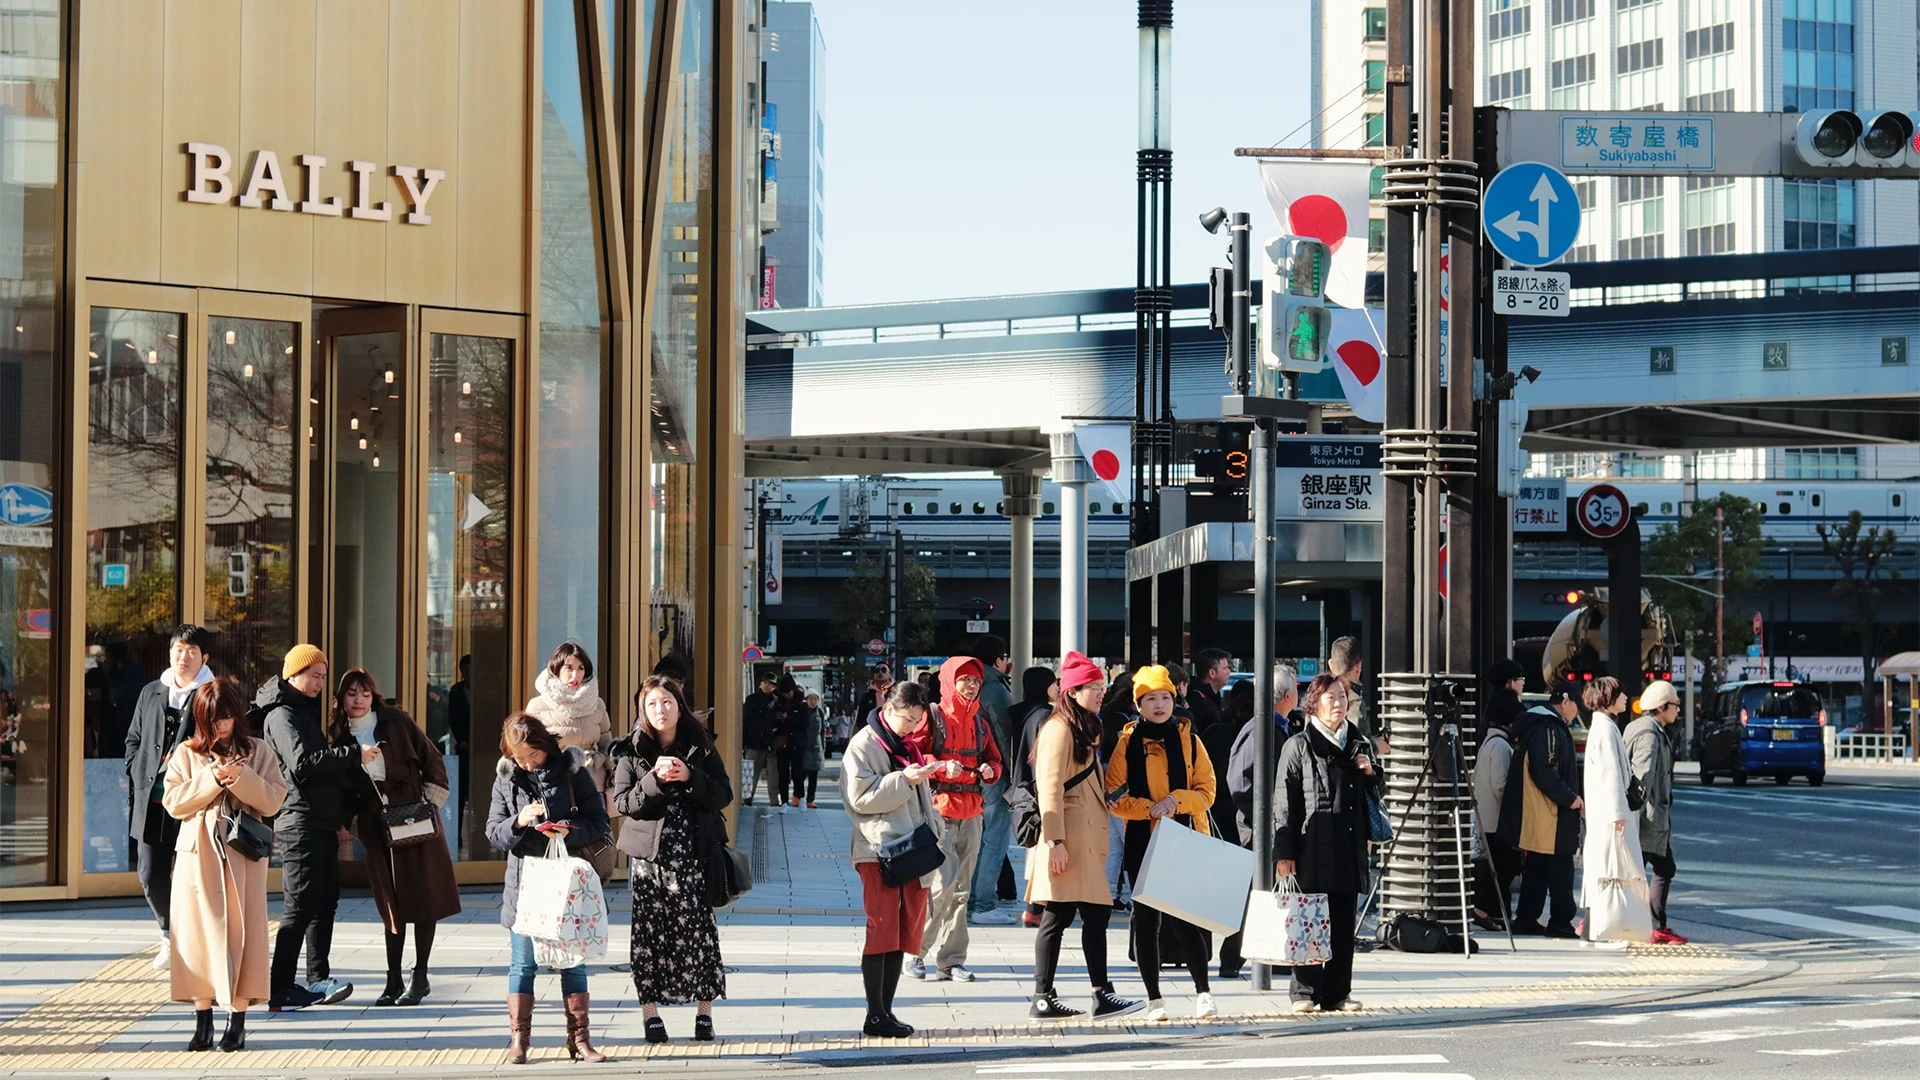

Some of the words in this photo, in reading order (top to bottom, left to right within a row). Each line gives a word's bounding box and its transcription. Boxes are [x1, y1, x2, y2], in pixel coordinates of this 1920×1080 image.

[1576, 125, 1699, 148] 数寄屋橋
[1600, 149, 1676, 163] Sukiyabashi
[184, 142, 446, 225] BALLY
[1498, 276, 1565, 292] 路線バスを除く
[1654, 351, 1671, 369] 新
[1310, 445, 1364, 456] 東京メトロ
[1226, 451, 1248, 479] 3
[1313, 457, 1336, 466] Tokyo
[1337, 457, 1361, 465] Metro
[1300, 473, 1372, 495] 銀座駅
[1515, 487, 1560, 501] 橋方面
[1302, 496, 1341, 510] Ginza
[1345, 496, 1372, 510] Sta.
